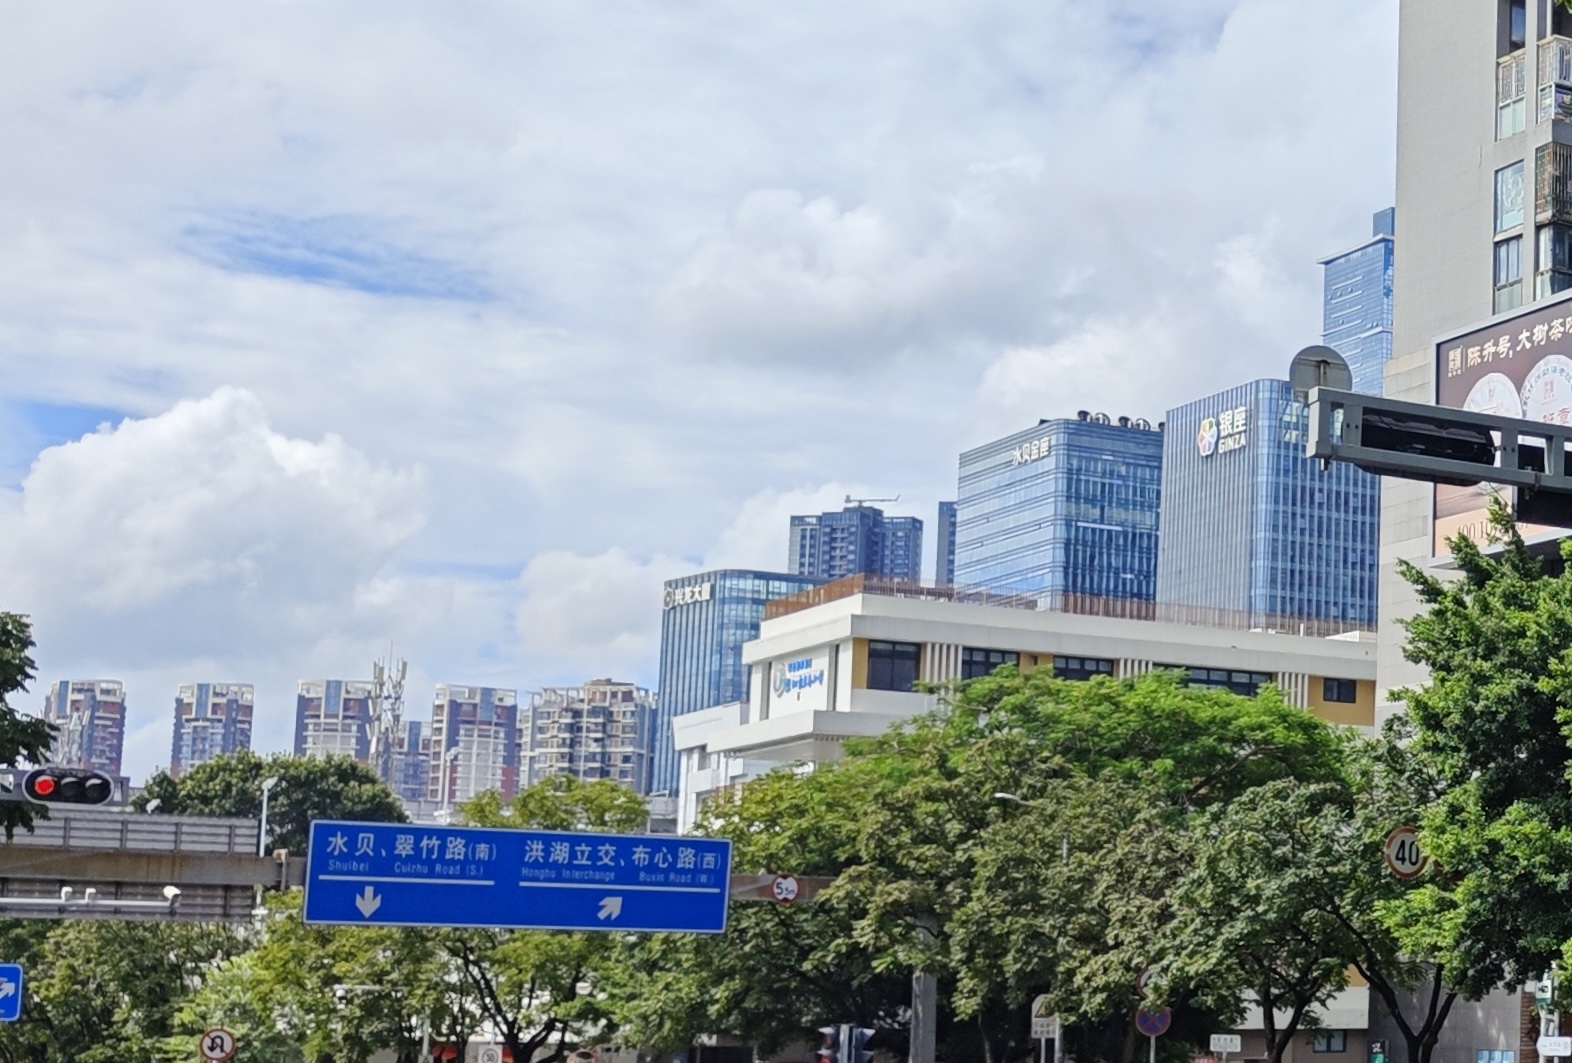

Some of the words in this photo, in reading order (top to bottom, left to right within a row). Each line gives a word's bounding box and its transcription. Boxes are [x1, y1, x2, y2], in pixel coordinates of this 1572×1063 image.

[1219, 406, 1247, 436] 银座
[1012, 436, 1050, 465] 水贝金座
[1218, 432, 1247, 454] GINZA
[327, 831, 496, 861] 水贝、翠竹路(南)
[524, 840, 721, 869] 洪湖立交、布心路(西)
[1395, 839, 1420, 866] 40
[328, 859, 369, 872] Shuibei
[394, 862, 428, 874] Cuizhu
[435, 864, 461, 875] Road
[521, 867, 556, 879] Honghu
[562, 868, 615, 882] Interchange
[639, 871, 665, 882] Buxin
[669, 872, 692, 883] Road
